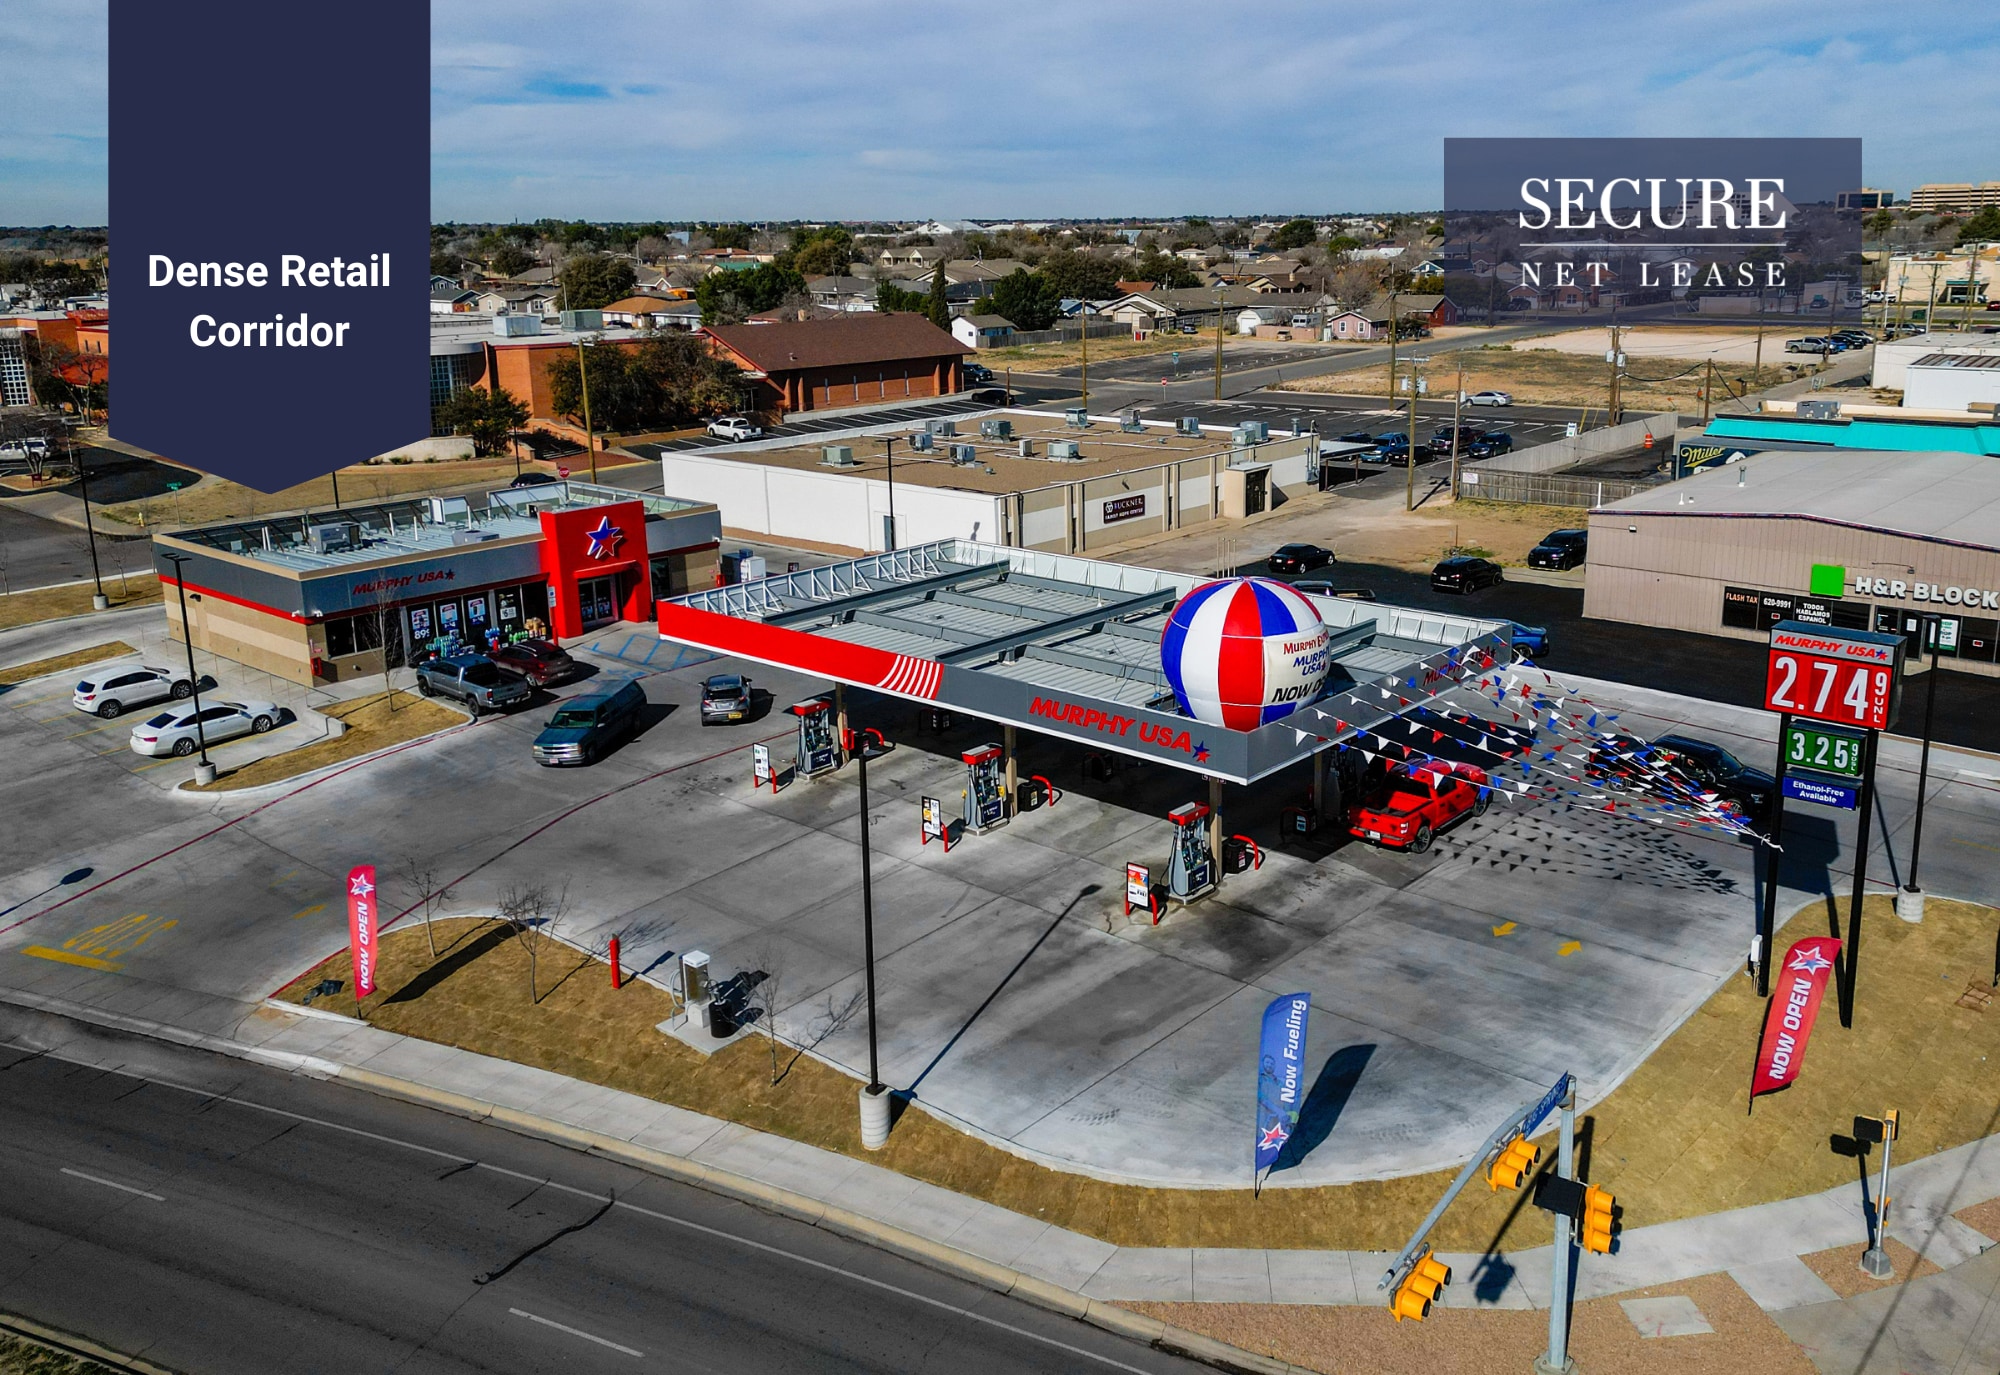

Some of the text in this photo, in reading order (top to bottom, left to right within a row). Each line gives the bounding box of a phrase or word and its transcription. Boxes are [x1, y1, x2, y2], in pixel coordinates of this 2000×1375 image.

[1680, 446, 1727, 465] Miller
[353, 570, 444, 595] MURPHY USA
[1855, 576, 2000, 611] H&R BLOCK
[1726, 592, 1759, 604] FLASH TAX
[1763, 598, 1791, 608] 620-9991
[1803, 603, 1824, 611] TODOS
[1796, 608, 1830, 617] HABLAMOS
[1775, 635, 1876, 658] MURPHY USA
[1302, 662, 1321, 676] USA
[1271, 682, 1313, 703] NOW
[1771, 656, 1869, 720] 2.74
[1029, 696, 1192, 753] MURPHY USA
[1791, 732, 1848, 768] 3.25
[1793, 781, 1844, 797] Ethanol-Free
[1800, 790, 1837, 803] Available
[357, 901, 369, 990] NOW OPEN
[1769, 977, 1812, 1080] NOW OPEN
[1280, 999, 1307, 1103] Now Fueling
